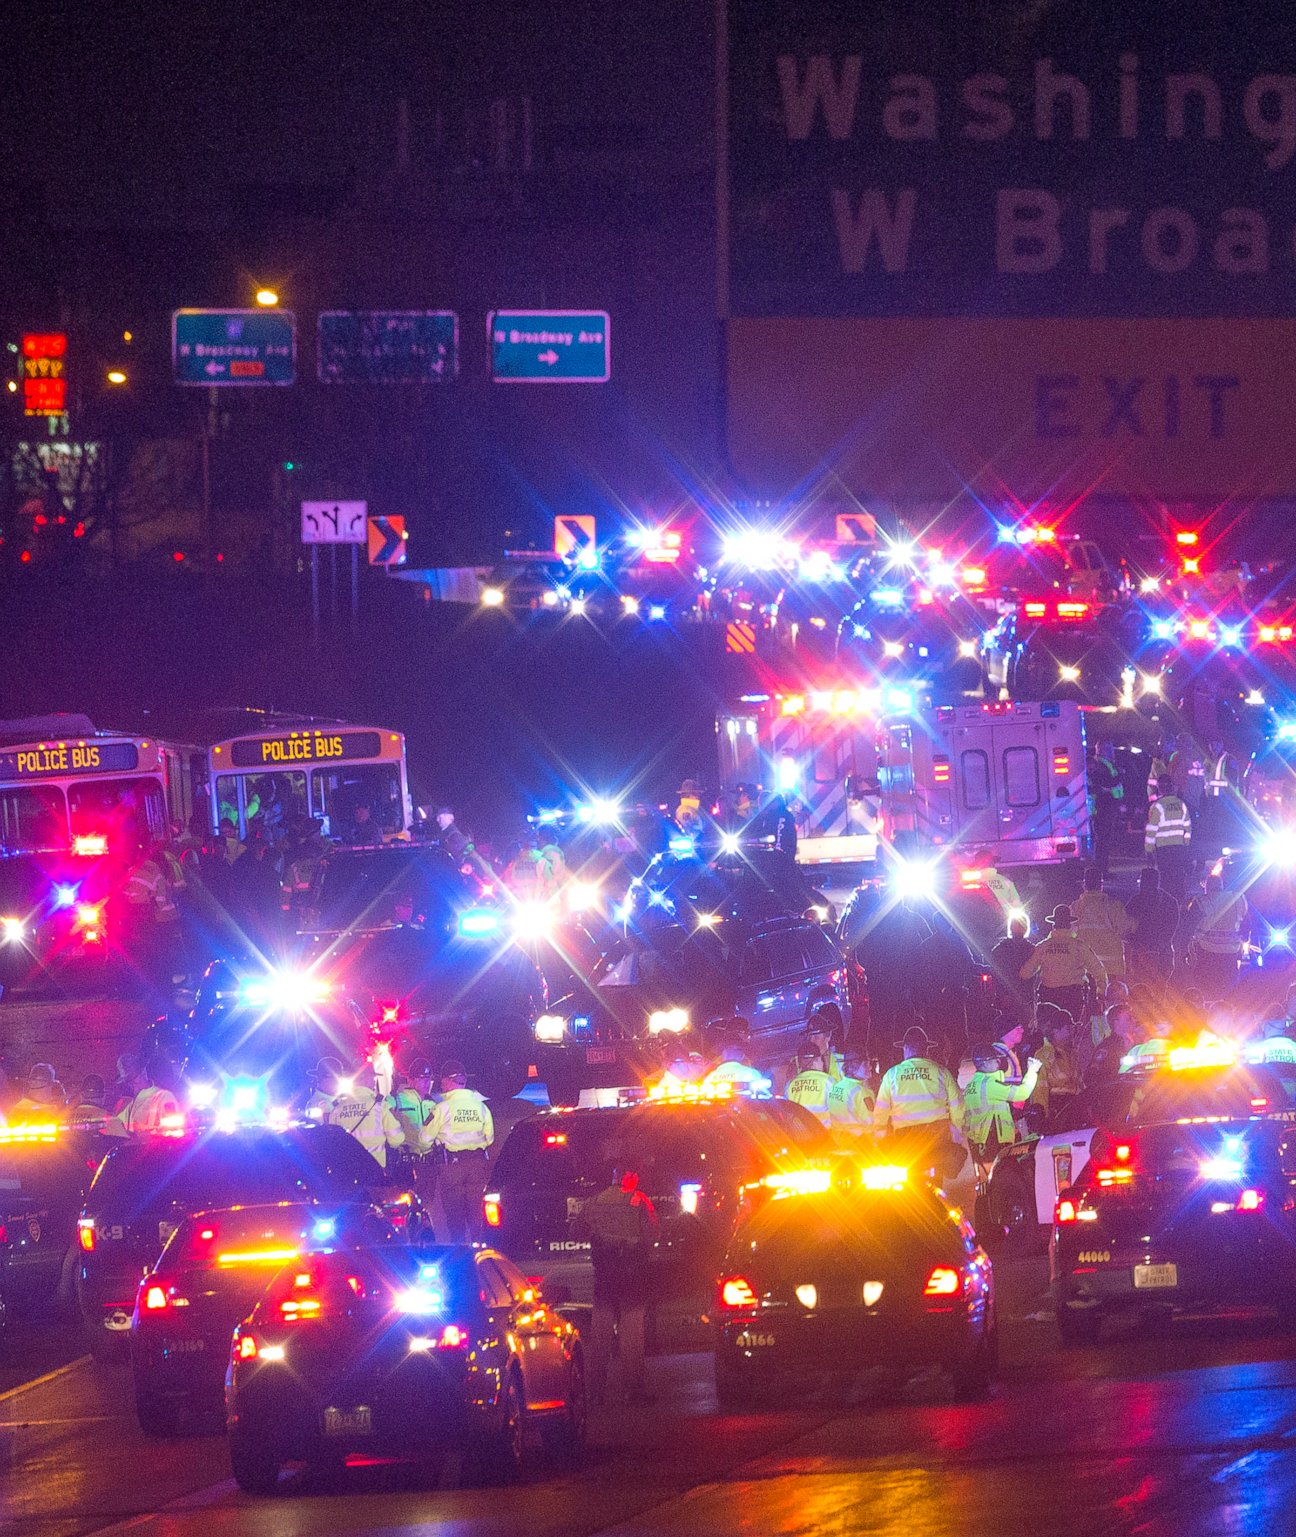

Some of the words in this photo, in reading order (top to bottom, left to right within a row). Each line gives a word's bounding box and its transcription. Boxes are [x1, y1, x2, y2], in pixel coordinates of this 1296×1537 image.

[832, 188, 918, 273] W
[1033, 374, 1240, 440] EXIT
[262, 739, 312, 761] POLICE
[315, 737, 343, 757] BUS
[17, 749, 68, 772] POLICE
[72, 747, 100, 768] BUS
[900, 1073, 932, 1081] PATROL
[791, 1085, 820, 1094] PATROL
[342, 1103, 366, 1111] STATE
[453, 1115, 482, 1123] PATROL
[95, 1225, 123, 1240] K-9
[1078, 1251, 1111, 1262] 44060
[736, 1334, 776, 1347] 41166
